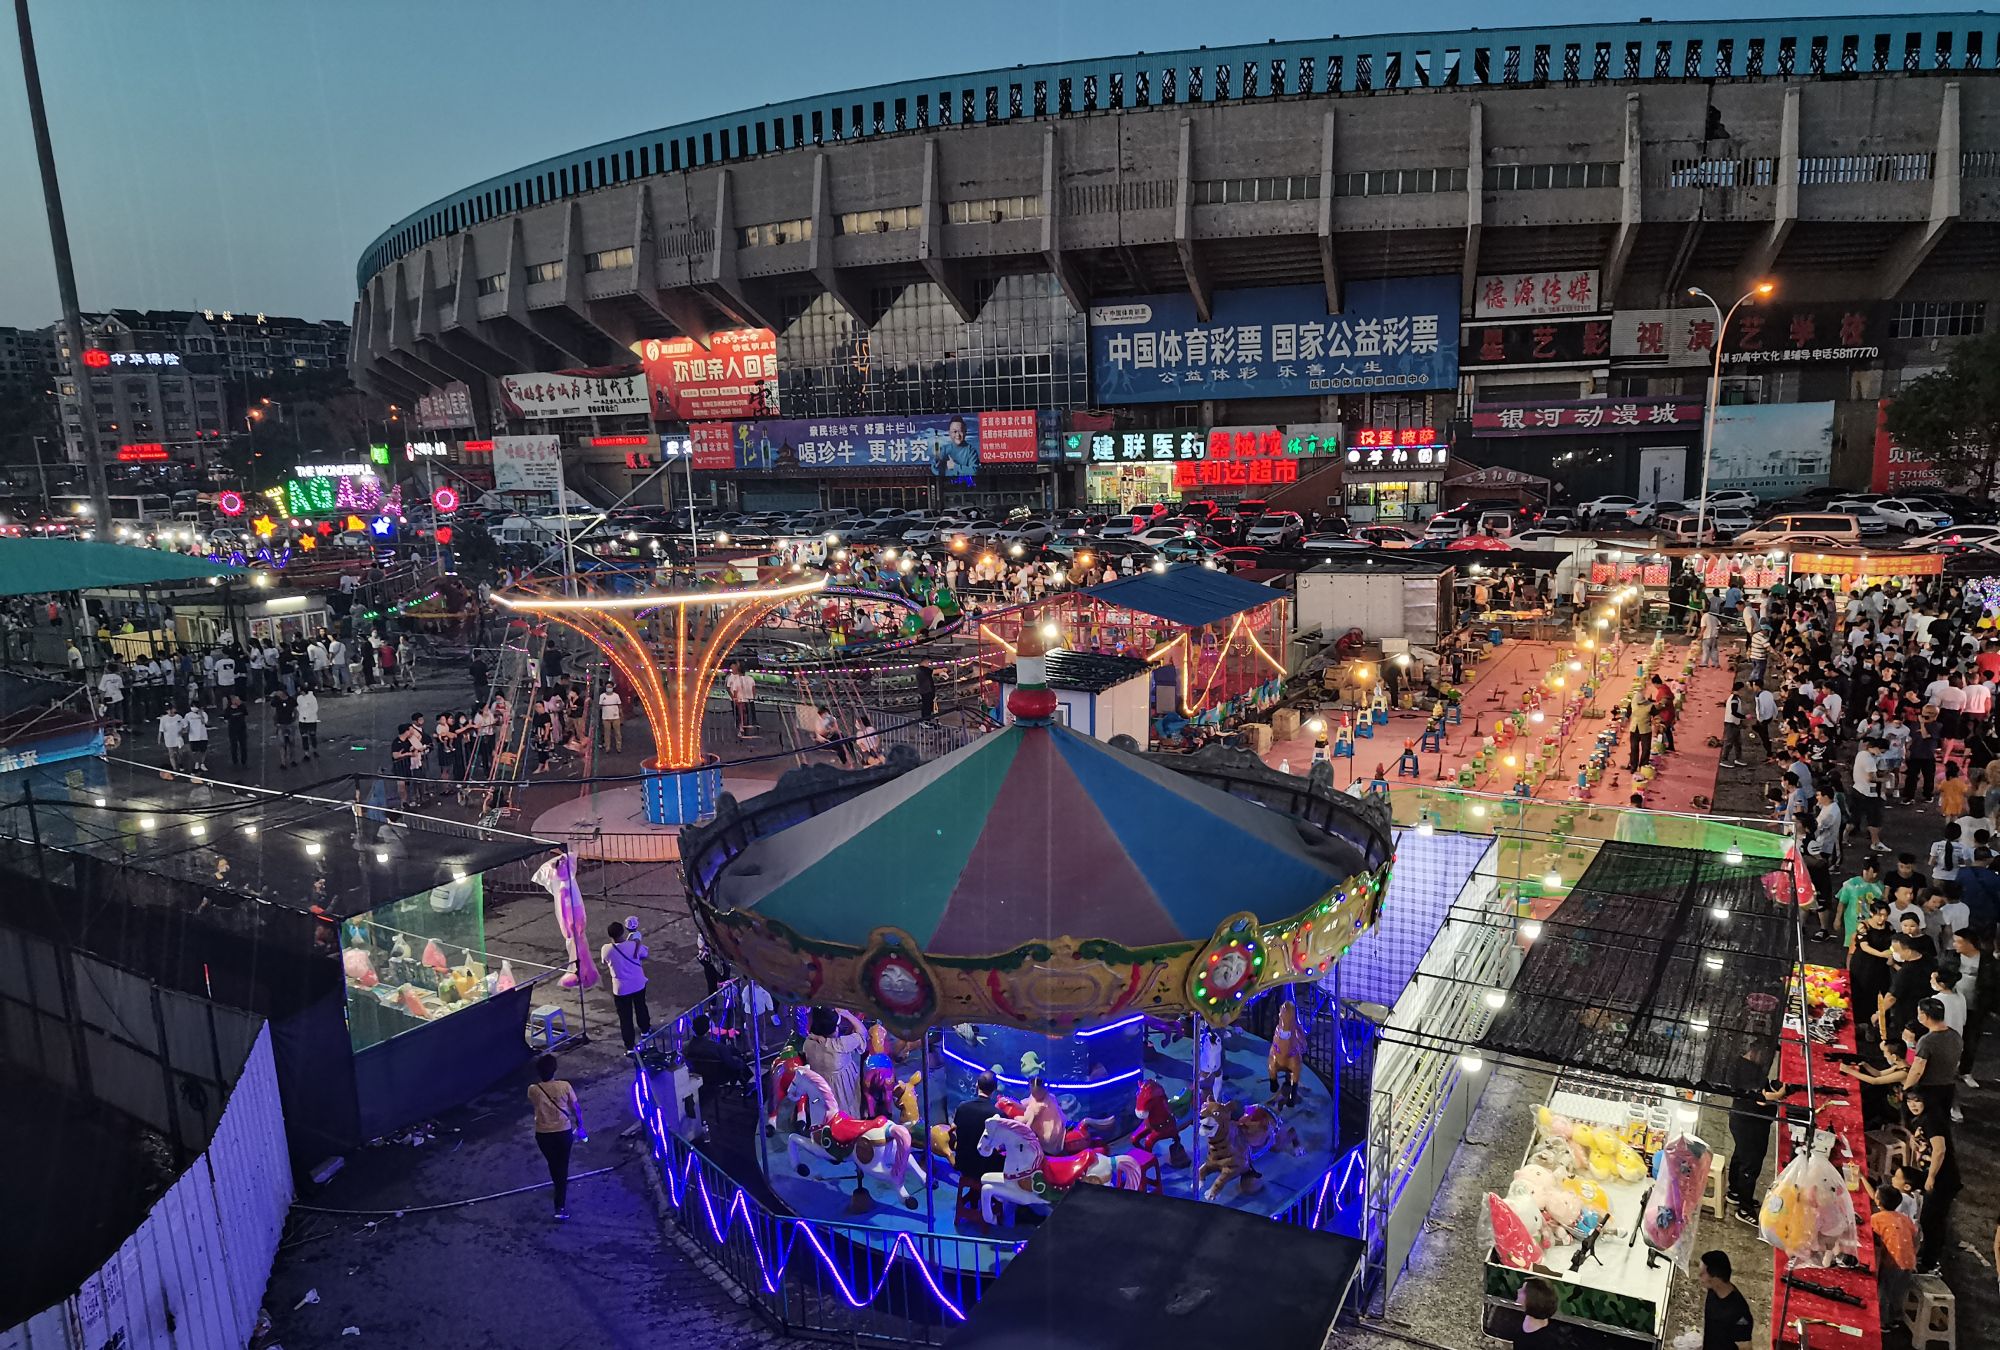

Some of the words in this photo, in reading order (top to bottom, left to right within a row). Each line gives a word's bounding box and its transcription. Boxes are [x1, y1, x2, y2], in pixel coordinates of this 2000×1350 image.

[1483, 272, 1593, 309] 德源传媒
[1108, 325, 1263, 370] 中国体育彩票
[1272, 314, 1439, 363] 国家公益彩票
[110, 352, 180, 365] 中华保险
[672, 354, 777, 382] 欢迎亲人回家
[1158, 367, 1259, 383] 公益体彩
[1277, 360, 1384, 377] 乐善人生
[1309, 373, 1430, 390] 抚顺市体育彩票管理中心
[1498, 403, 1680, 429] 银河动漫城
[809, 424, 859, 437] 亲民接地气
[864, 422, 916, 435] 好酒牛栏山
[1360, 430, 1394, 445] 汉堡
[1401, 429, 1435, 444] 披萨
[798, 440, 856, 464] 喝珍牛
[868, 438, 930, 463] 更讲究
[1092, 432, 1205, 461] 建联医药
[1210, 430, 1283, 458] 器械城
[1287, 434, 1337, 455] 体育场
[294, 465, 314, 477] THE
[314, 464, 375, 476] WONDERFUL
[1174, 459, 1298, 485] 惠利达超市
